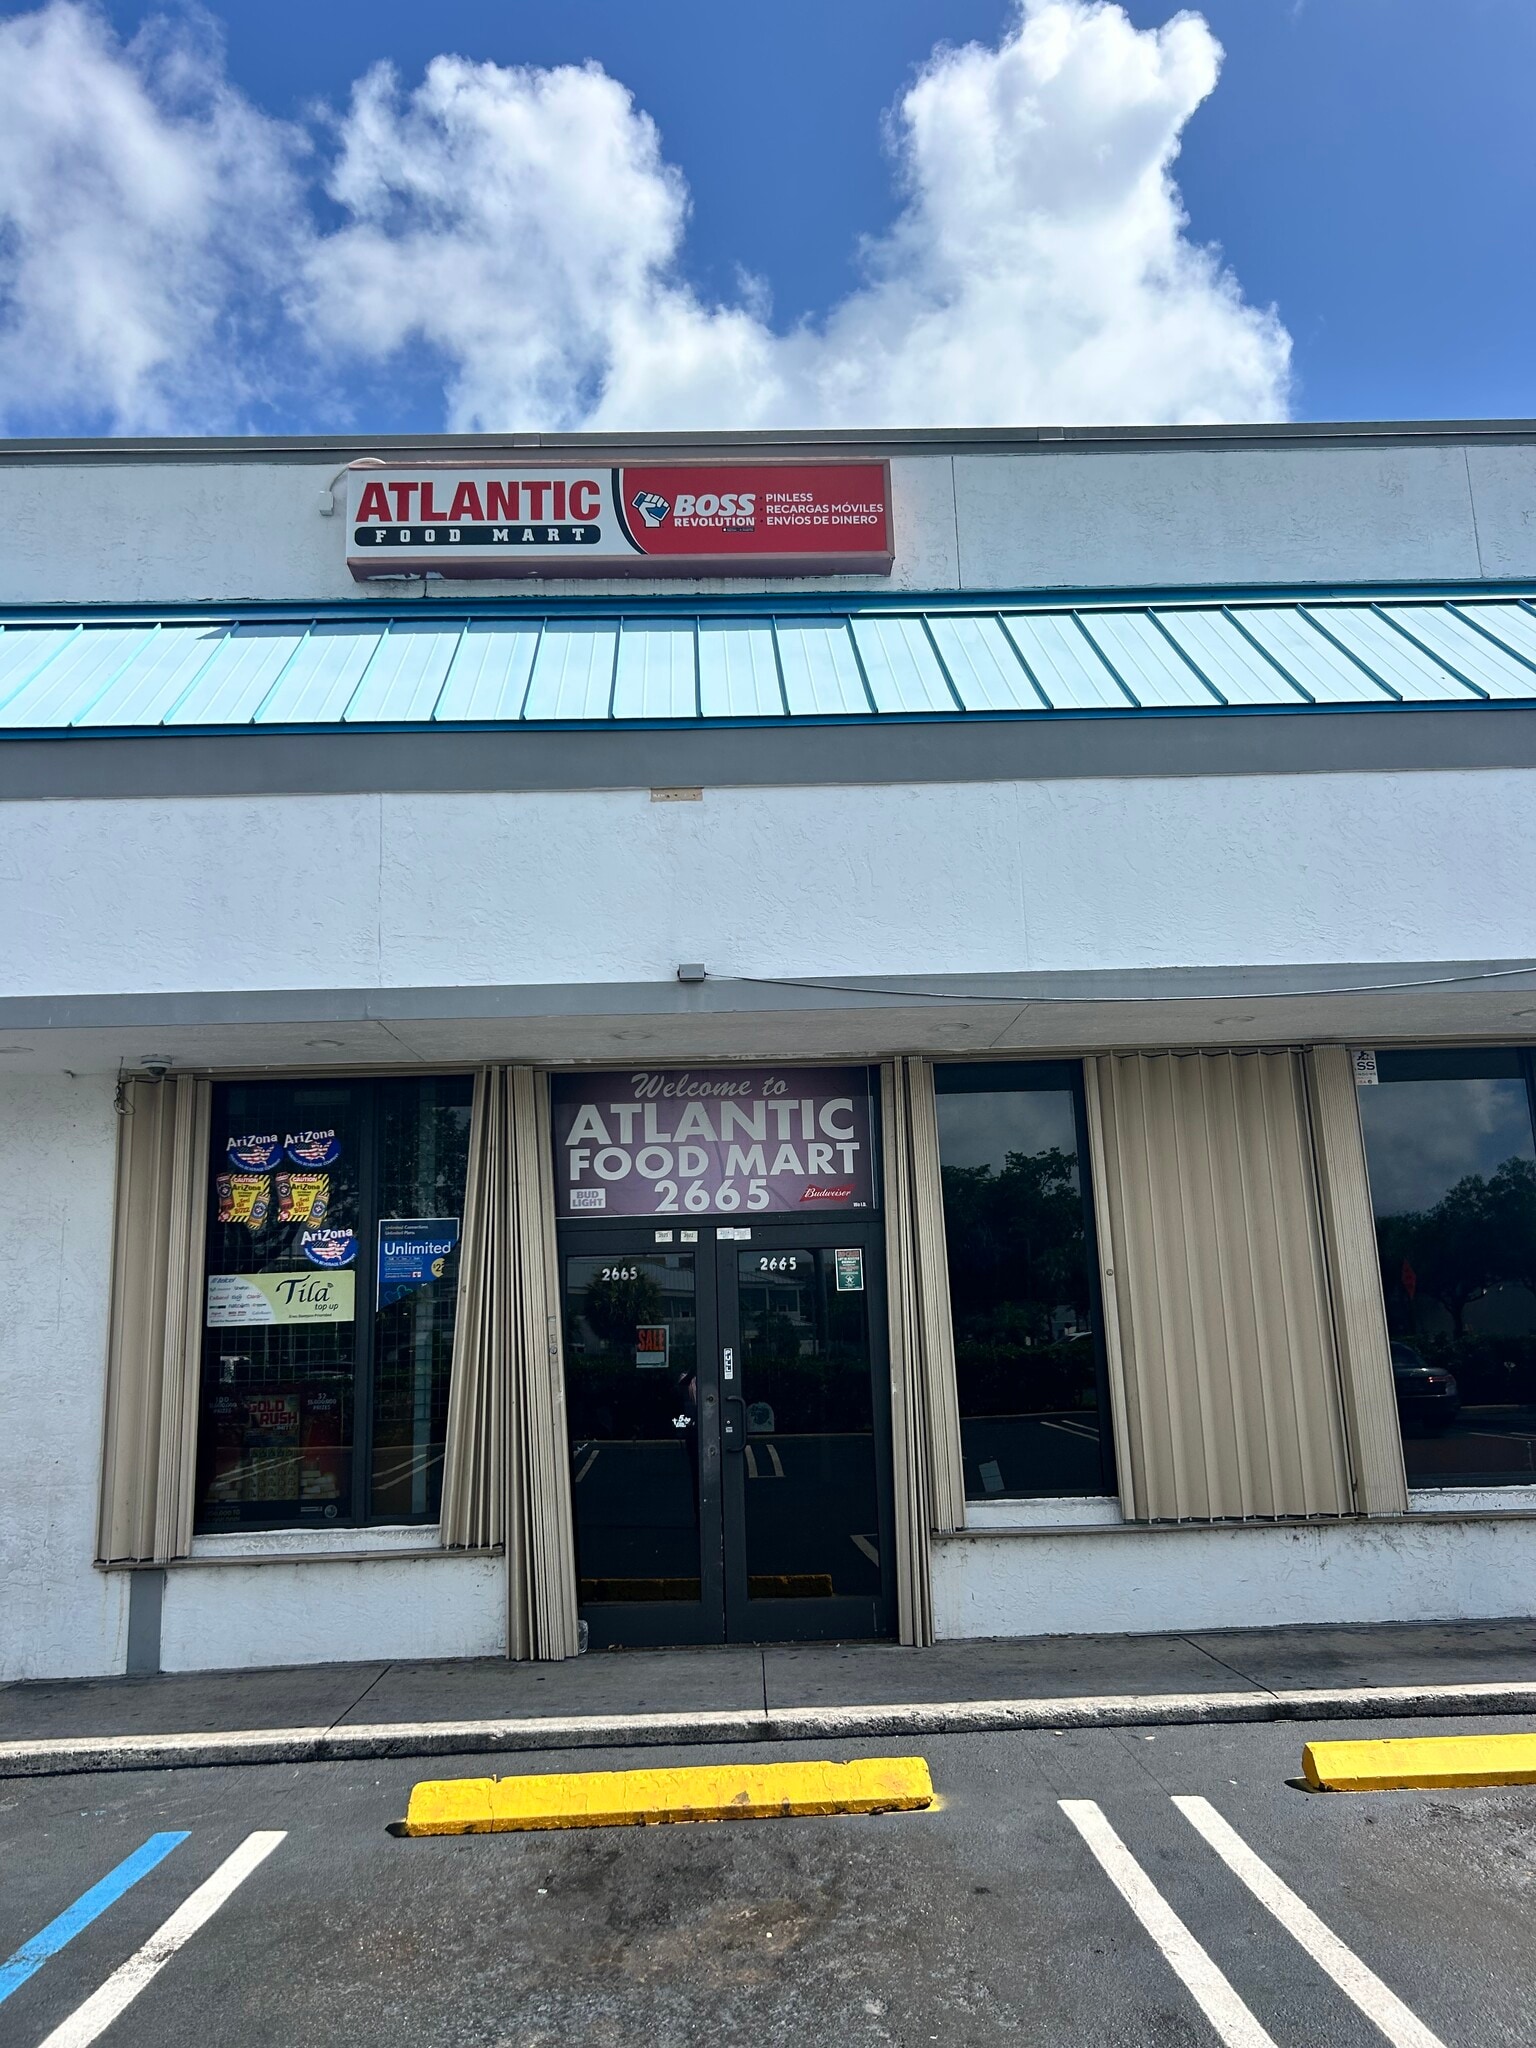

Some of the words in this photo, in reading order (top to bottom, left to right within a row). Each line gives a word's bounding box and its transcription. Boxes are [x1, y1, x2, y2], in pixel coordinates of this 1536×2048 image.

[355, 480, 601, 522] ATLANTIC
[673, 493, 756, 517] BOSS
[765, 493, 813, 502] PINLESS
[766, 504, 829, 514] RECARGAS
[831, 502, 884, 513] MÓVILES
[674, 517, 755, 527] REVOLUTION
[766, 514, 811, 525] ENVÍOS
[813, 516, 829, 525] DE
[831, 515, 878, 525] DINERO
[375, 529, 461, 543] FOOD
[493, 528, 585, 542] MART
[631, 1074, 752, 1099] Welcome
[762, 1077, 788, 1096] to
[565, 1098, 854, 1146] ATLANTIC
[226, 1134, 279, 1151] AriZona
[283, 1129, 335, 1149] AriZona
[569, 1145, 709, 1181] FOOD
[725, 1142, 860, 1176] MART
[576, 1191, 599, 1199] BUD
[654, 1178, 770, 1212] 2665
[804, 1187, 851, 1198] Budweiser
[572, 1198, 603, 1207] LIGHT
[301, 1229, 353, 1245] AriZona
[385, 1241, 451, 1255] Unlimited
[760, 1257, 797, 1271] 2665
[601, 1266, 638, 1281] 2665
[276, 1275, 330, 1304] Tila
[637, 1328, 665, 1351] SALE
[259, 1412, 298, 1425] RUSH
